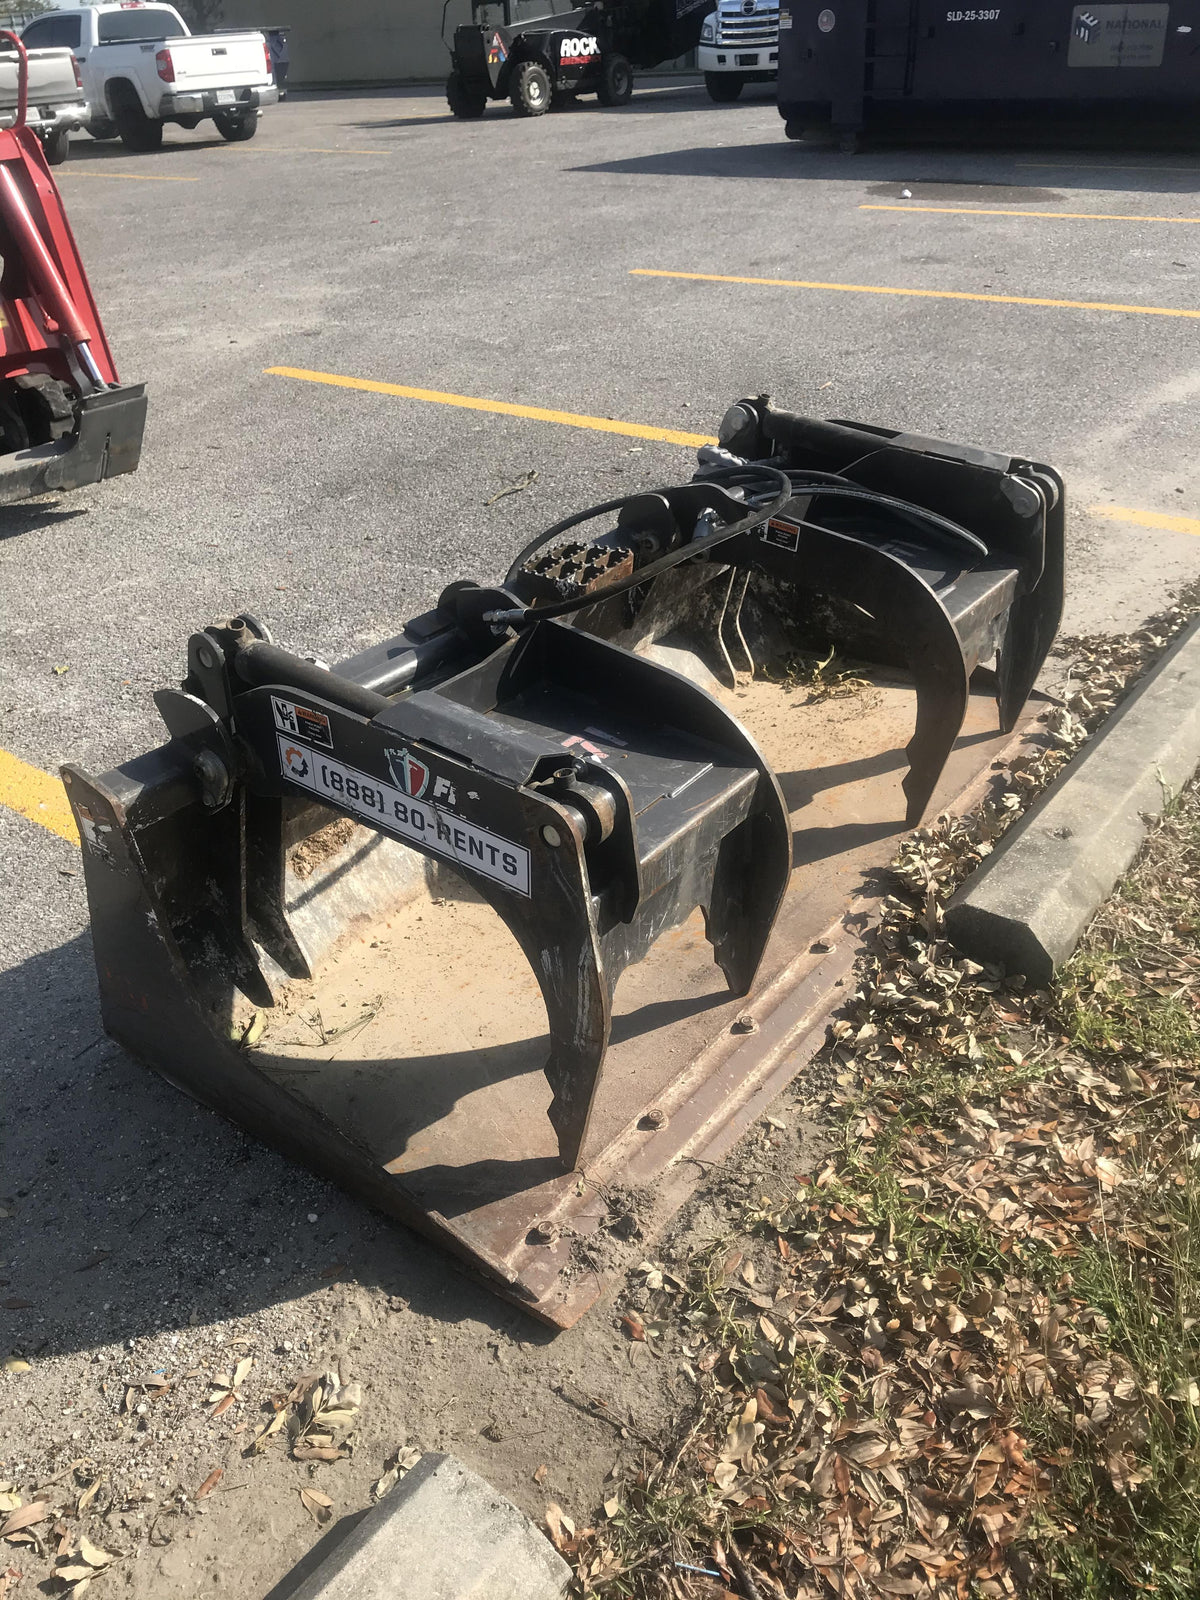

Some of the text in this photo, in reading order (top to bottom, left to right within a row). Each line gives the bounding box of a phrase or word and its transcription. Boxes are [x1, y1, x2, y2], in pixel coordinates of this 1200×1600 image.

[947, 10, 1000, 21] SLD-25-3307
[560, 37, 601, 57] ROCK
[321, 764, 385, 814] (888)
[394, 802, 518, 876] 80-RENTS
